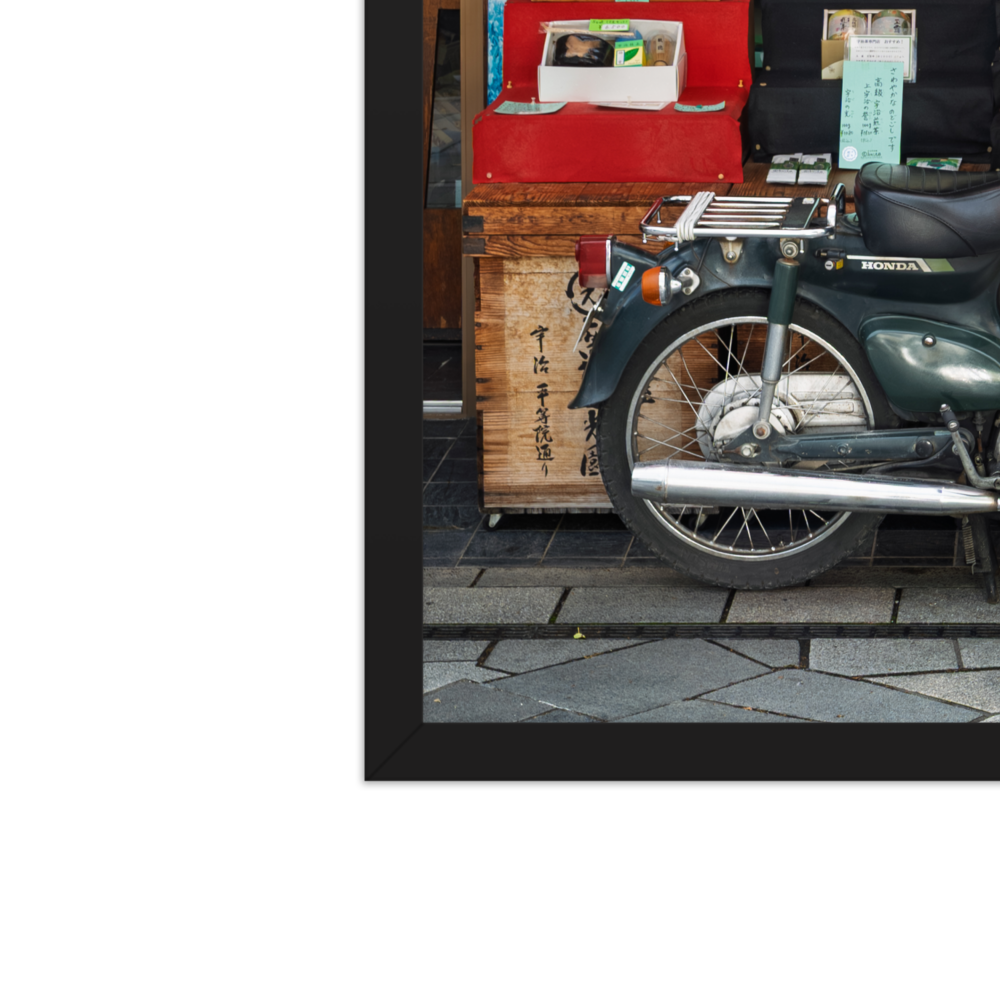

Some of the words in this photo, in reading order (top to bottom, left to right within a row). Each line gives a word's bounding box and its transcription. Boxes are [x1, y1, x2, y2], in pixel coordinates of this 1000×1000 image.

[874, 77, 883, 98] 高級
[889, 67, 898, 106] さわやかな
[873, 99, 882, 135] 宇治煎茶
[888, 136, 897, 153] です
[861, 261, 919, 271] HONDA
[530, 325, 550, 375] 宇治
[532, 382, 555, 478] 平等院通り
